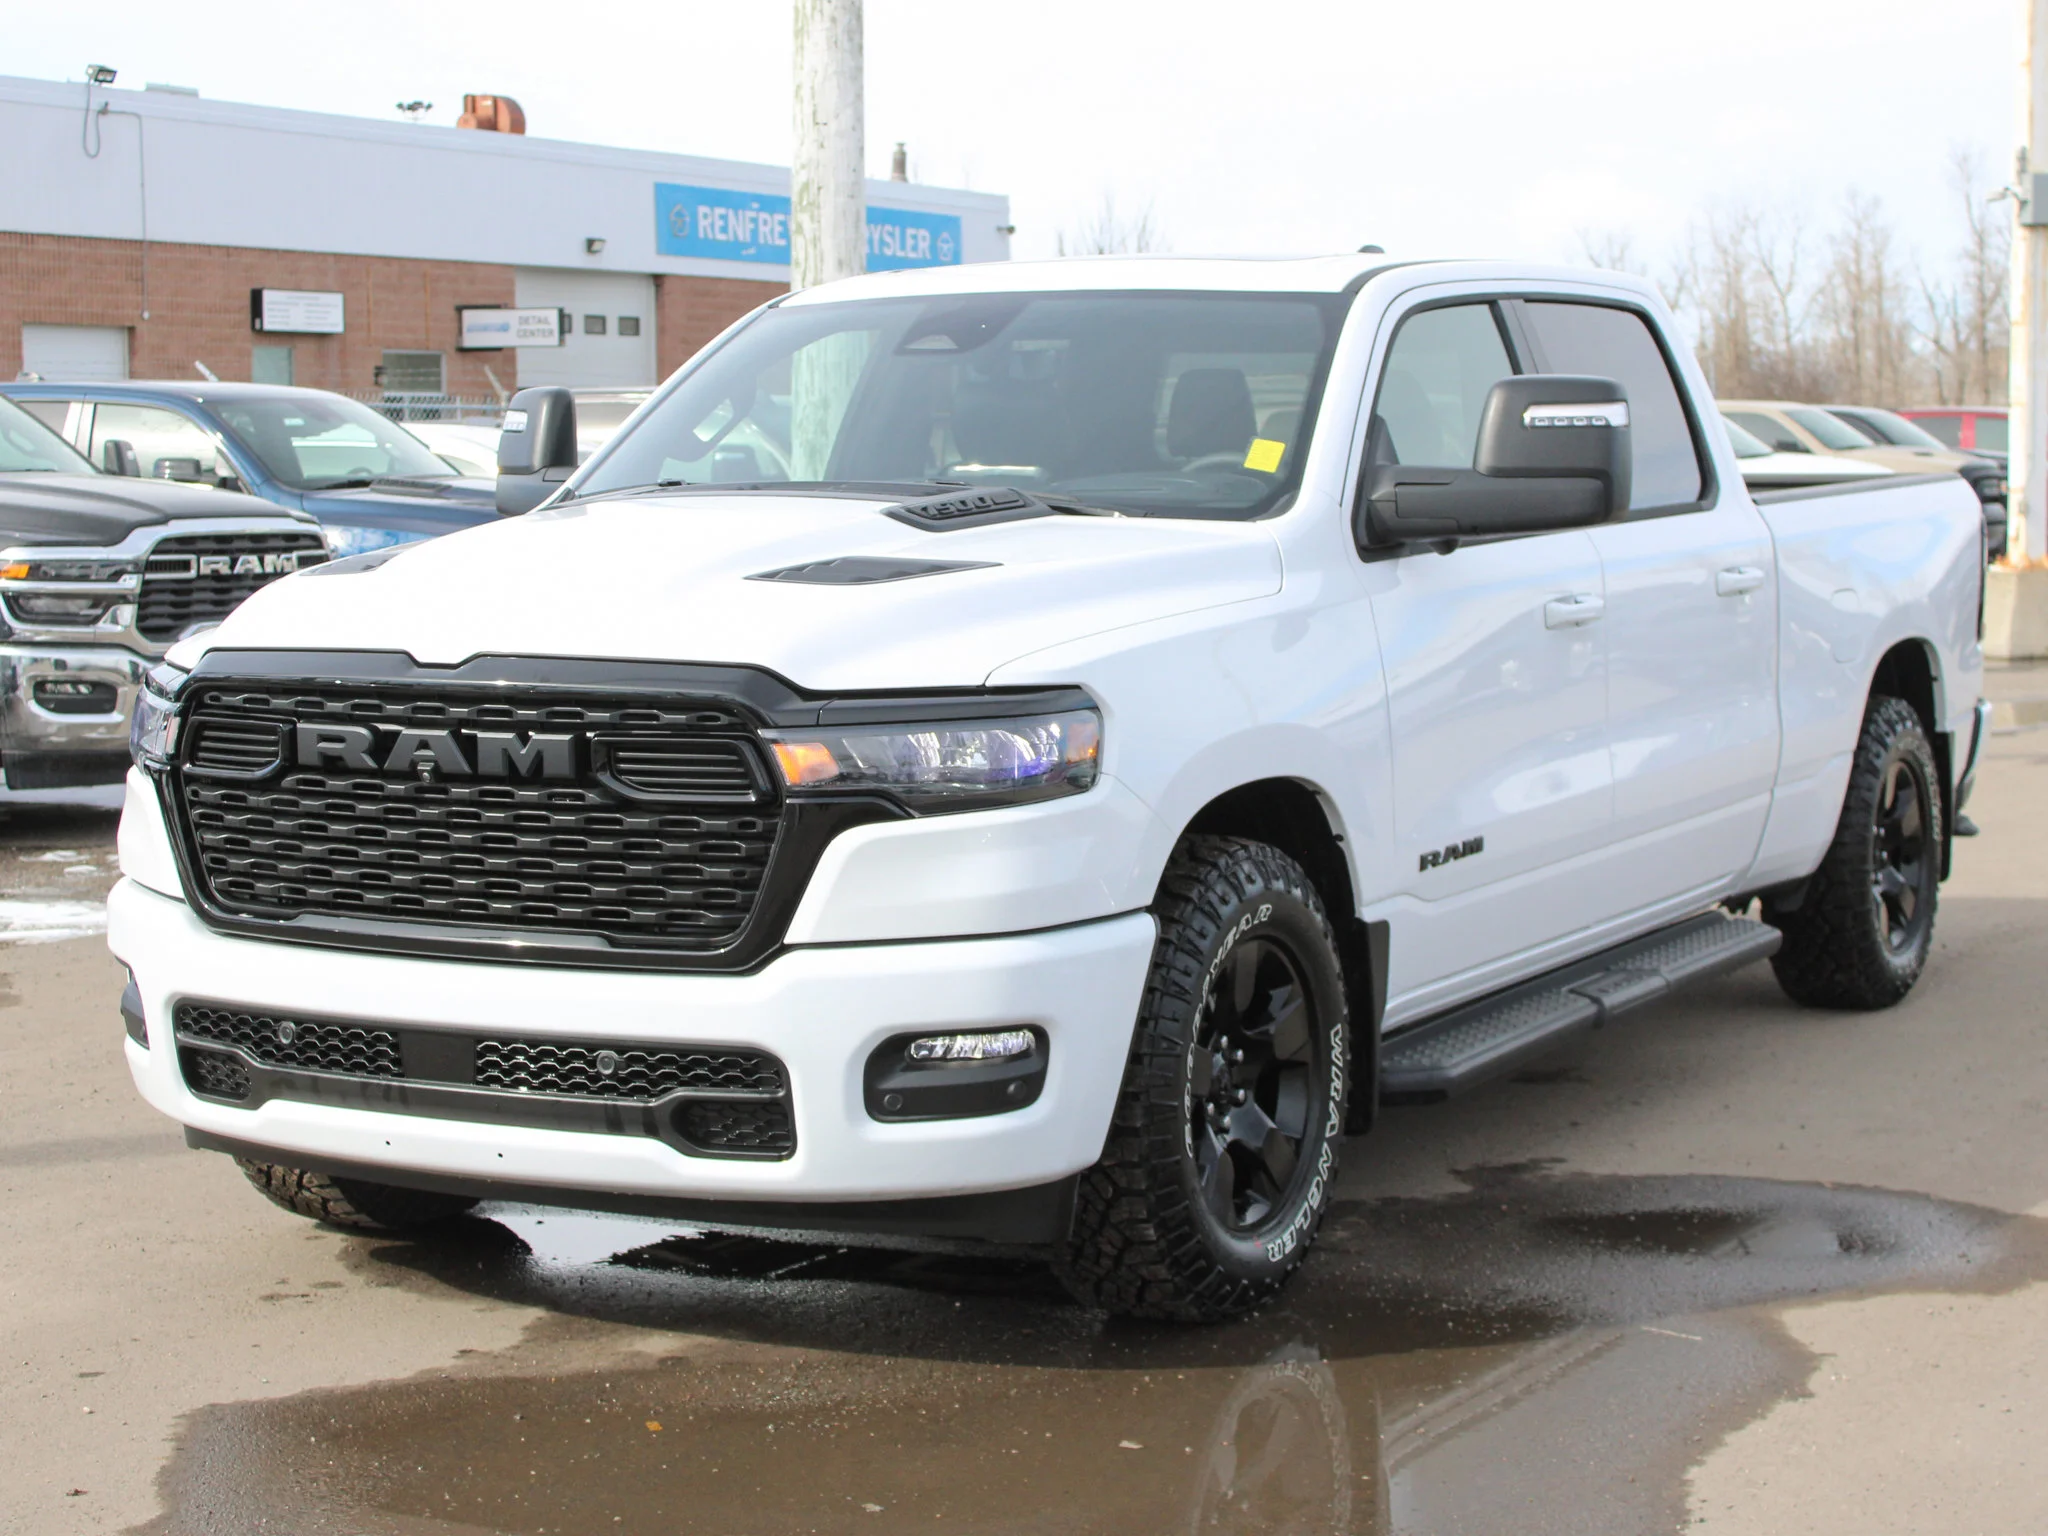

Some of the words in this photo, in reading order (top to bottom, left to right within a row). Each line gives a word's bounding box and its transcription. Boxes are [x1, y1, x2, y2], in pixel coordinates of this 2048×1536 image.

[697, 204, 791, 246] RENFRE
[516, 327, 554, 339] CENTER
[518, 315, 551, 326] DETAIL
[922, 494, 994, 517] 1500
[199, 553, 293, 575] RAM
[297, 722, 575, 780] RAM
[1419, 836, 1484, 872] RAM
[1267, 1023, 1343, 1262] WRANGLER
